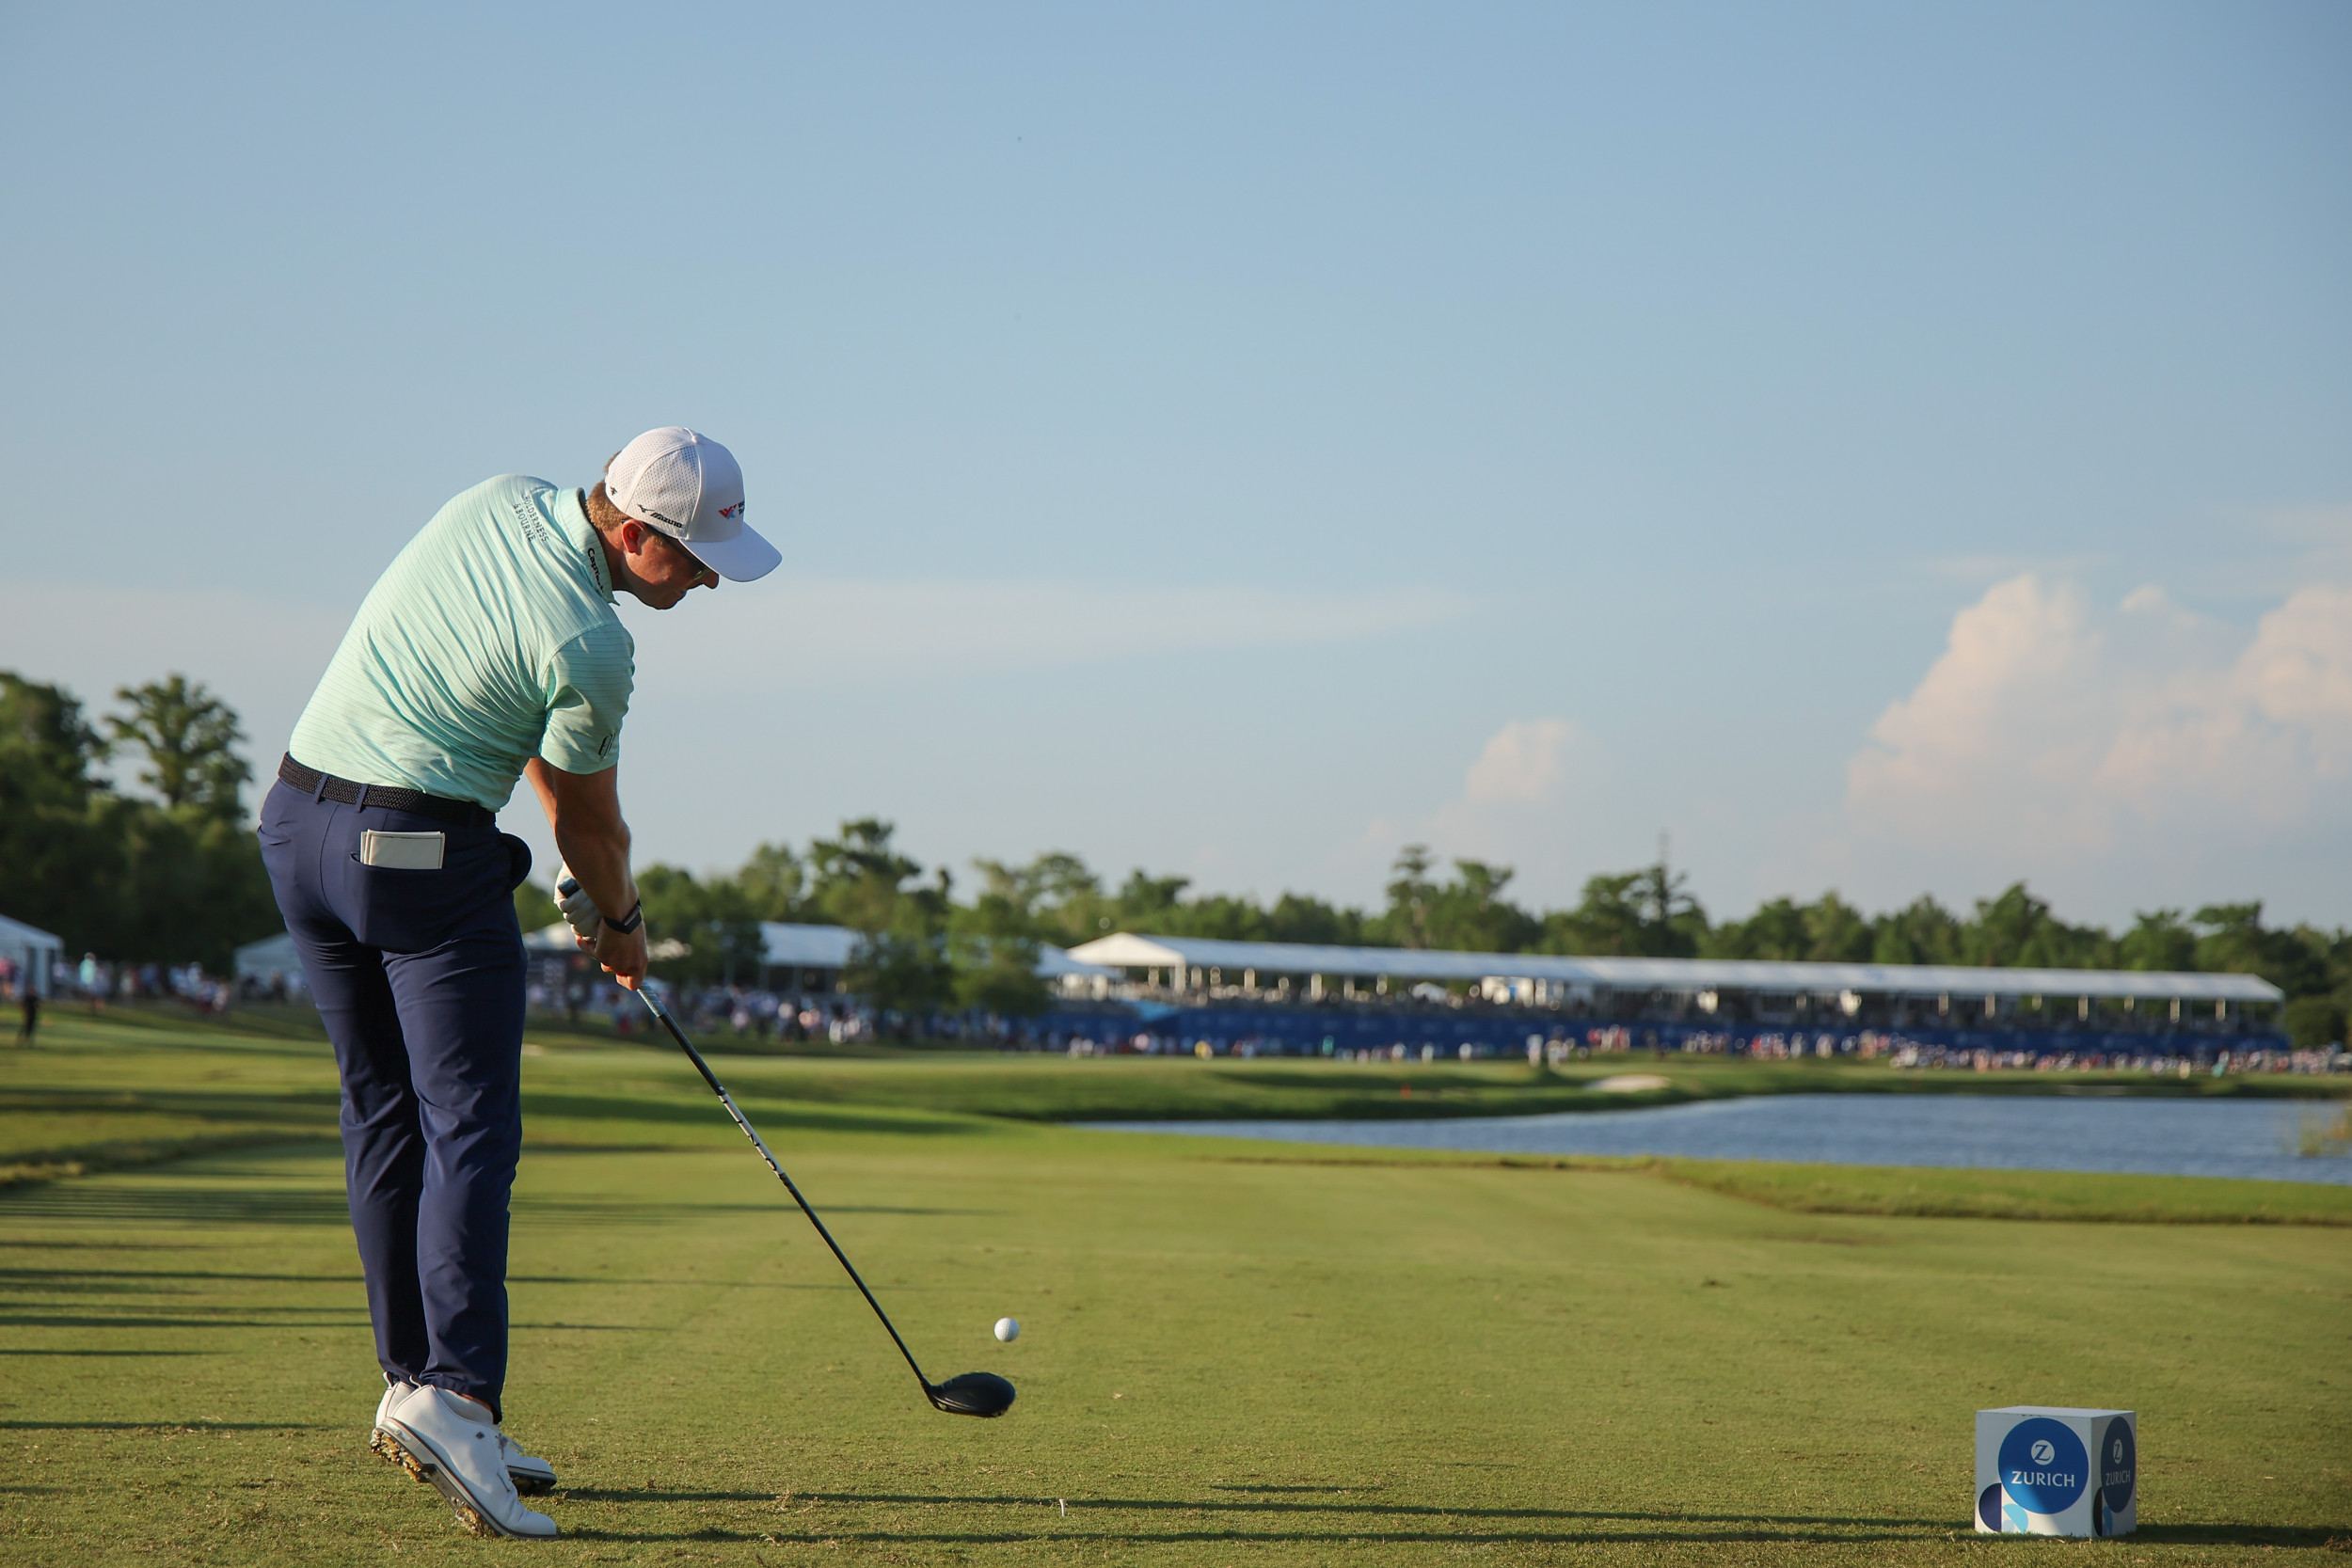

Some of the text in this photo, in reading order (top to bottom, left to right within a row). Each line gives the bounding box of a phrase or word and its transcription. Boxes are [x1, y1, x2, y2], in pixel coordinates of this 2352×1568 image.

[515, 508, 536, 543] BOURNE
[522, 494, 549, 543] HOLDERNESS
[2033, 1444, 2052, 1462] Z
[2010, 1470, 2075, 1488] ZURICH
[2106, 1469, 2131, 1486] ZURICH
